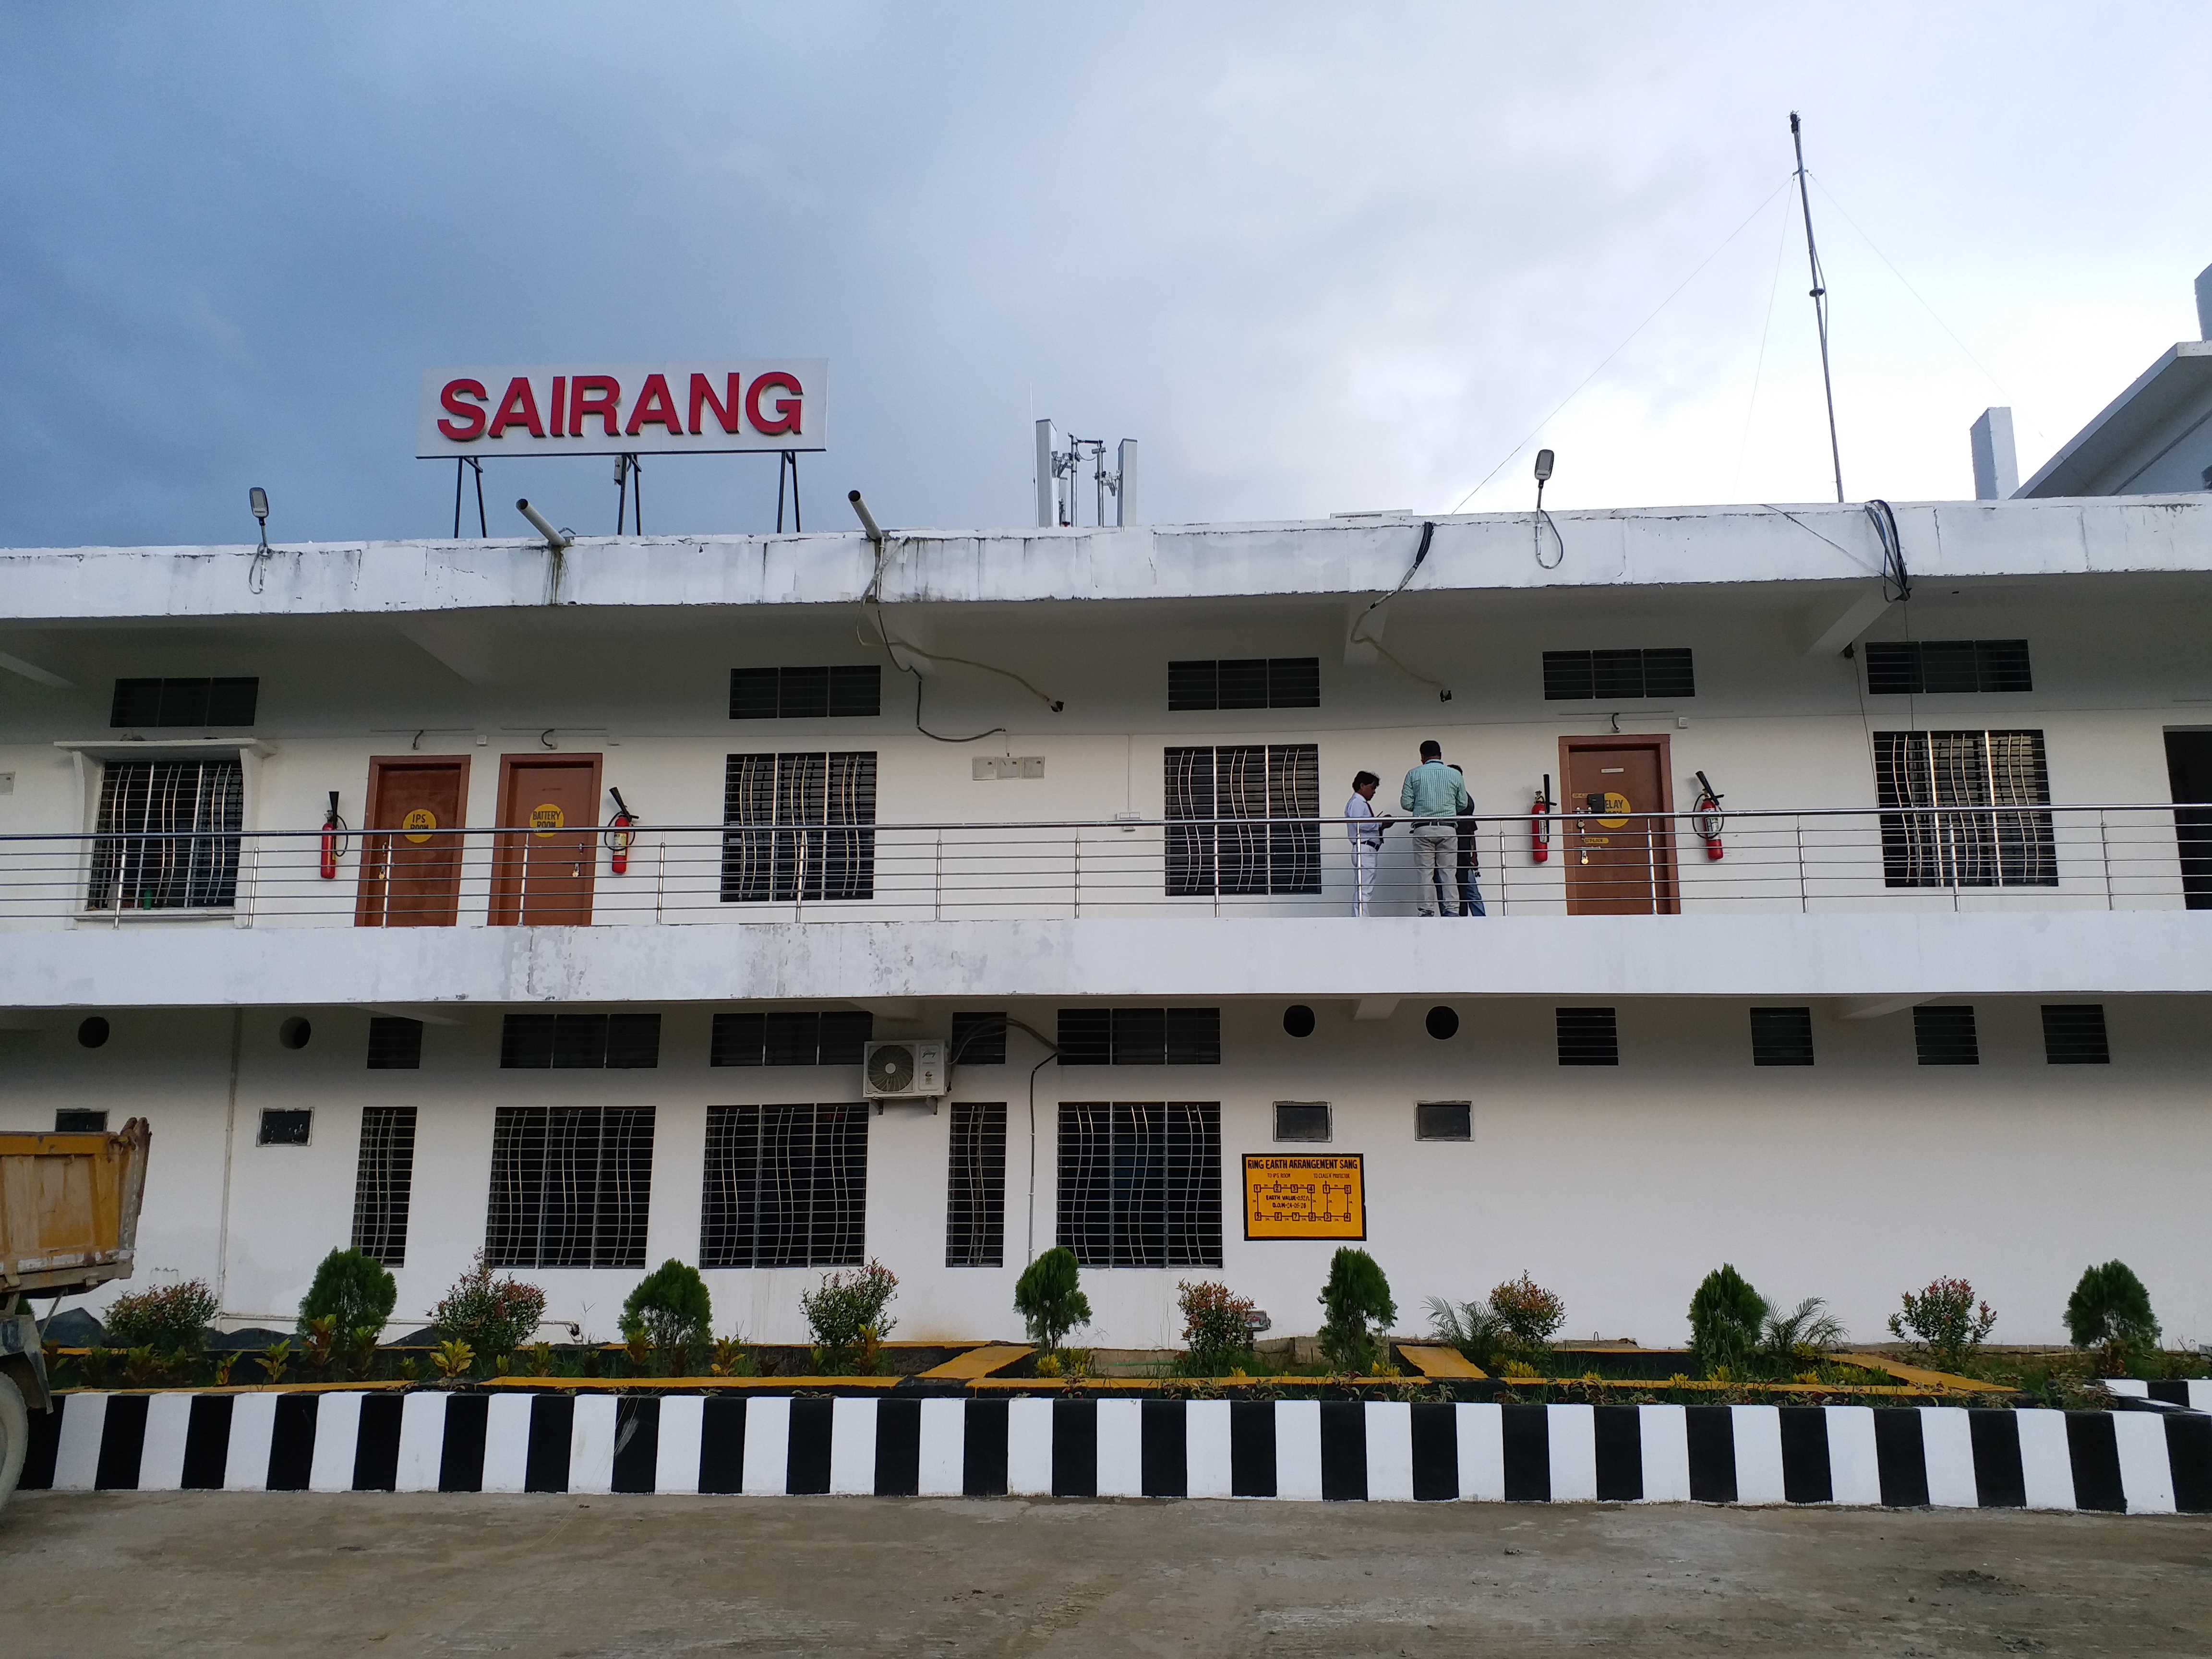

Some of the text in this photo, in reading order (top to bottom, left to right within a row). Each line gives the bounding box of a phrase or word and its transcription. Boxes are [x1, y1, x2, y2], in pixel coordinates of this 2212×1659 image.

[437, 372, 804, 441] SAIRANG
[1605, 800, 1623, 808] ELAY
[413, 814, 426, 823] IPS
[533, 811, 561, 820] BATTERY
[1248, 1159, 1358, 1169] RING EARTH ARRANGEMENT SANG
